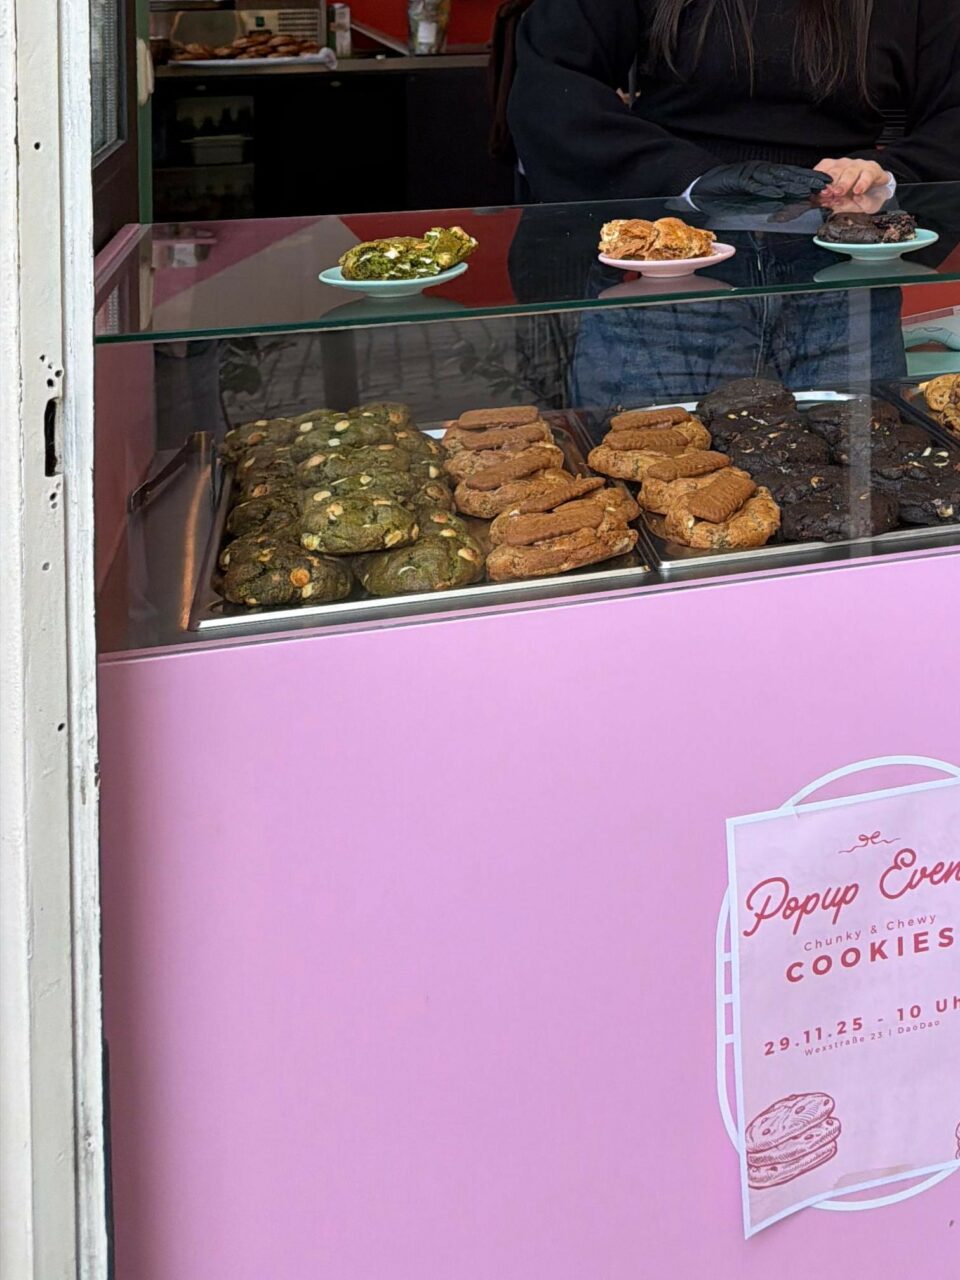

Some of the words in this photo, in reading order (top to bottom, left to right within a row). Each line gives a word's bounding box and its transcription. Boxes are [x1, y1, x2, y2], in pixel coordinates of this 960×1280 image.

[743, 877, 859, 937] Popup
[786, 927, 955, 983] COOKIES
[803, 930, 862, 952] Chunky
[870, 925, 878, 934] &
[886, 914, 937, 932] Chewy
[764, 1017, 864, 1056] 29.11.25
[896, 1005, 922, 1022] 10
[804, 1035, 866, 1057] Wexstraße
[870, 1030, 884, 1041] 23
[897, 1019, 941, 1035] DaoDao
